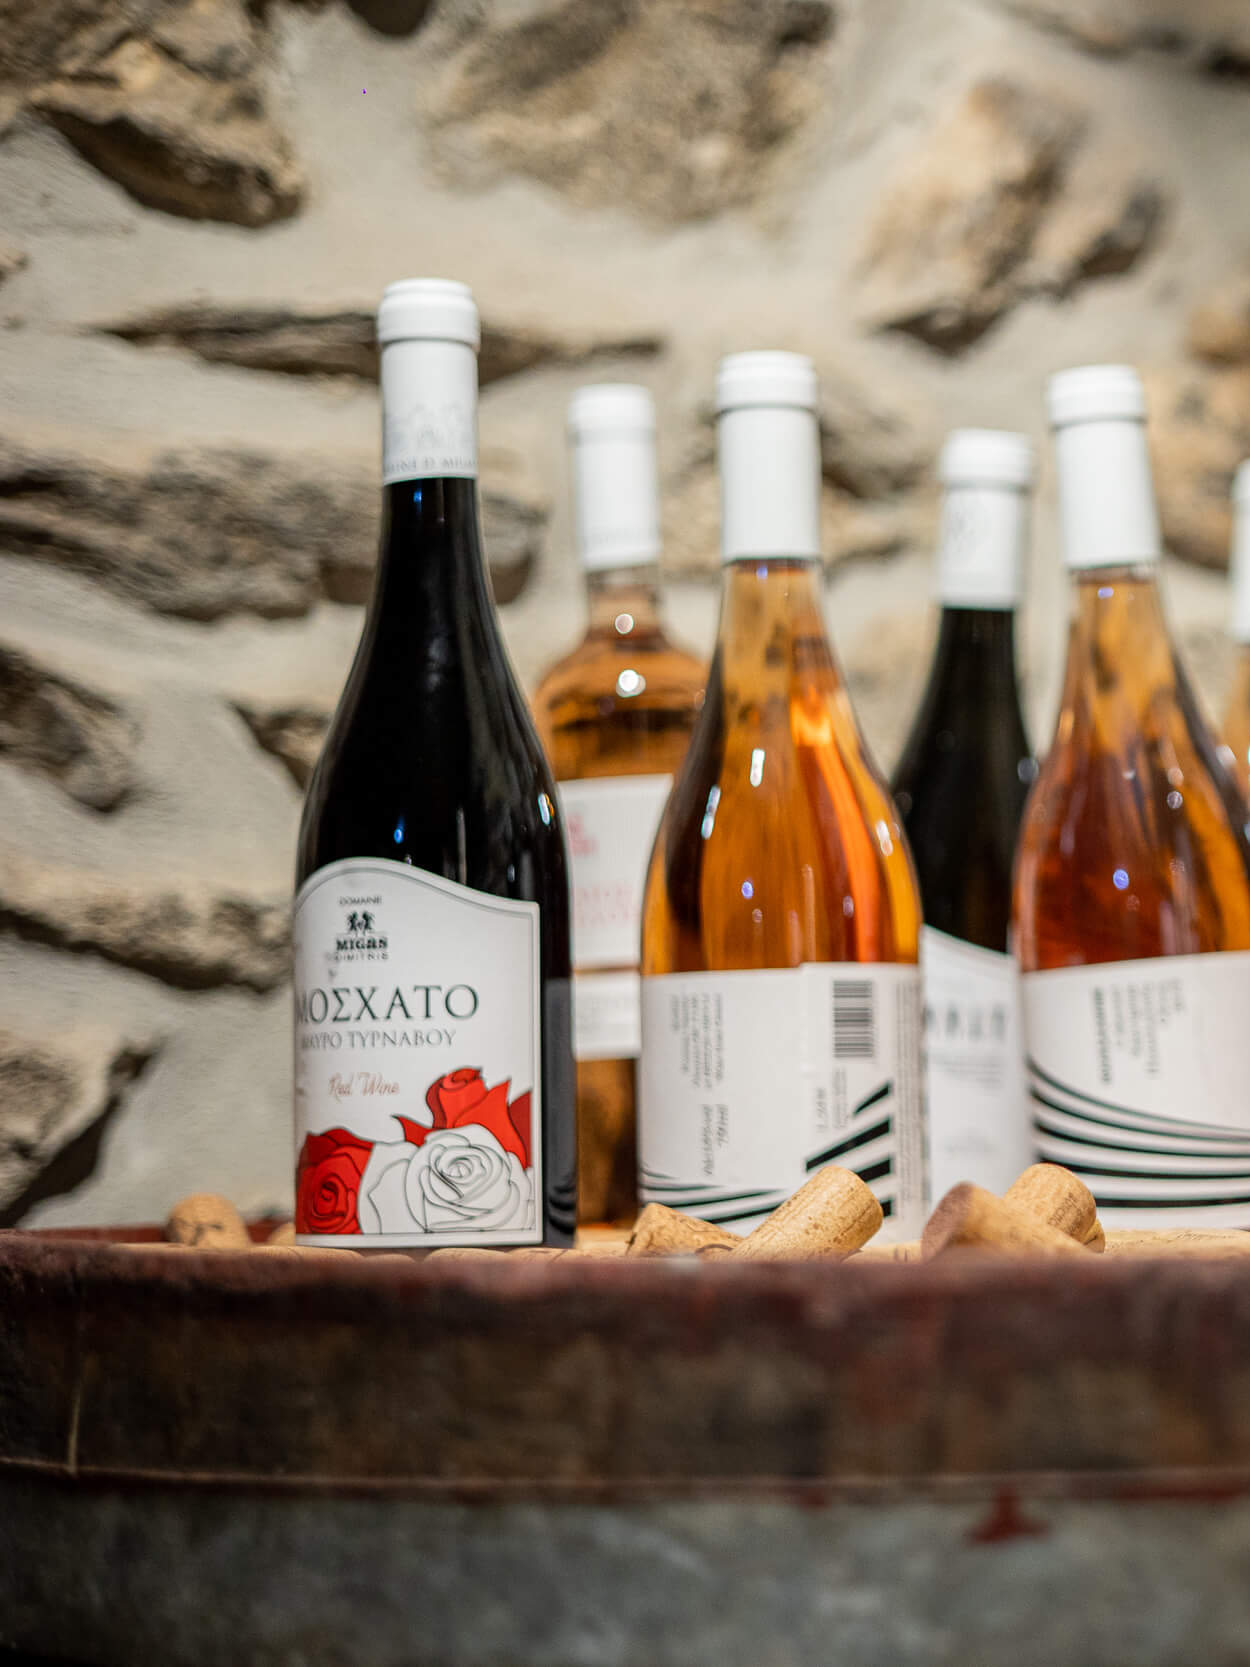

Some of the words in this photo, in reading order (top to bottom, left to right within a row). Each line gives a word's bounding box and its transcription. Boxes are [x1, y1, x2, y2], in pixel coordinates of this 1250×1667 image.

[347, 1028, 457, 1049] ΤΥΡΝΑΒΟΥ
[328, 1072, 354, 1102] Red
[358, 1071, 400, 1096] Wine
